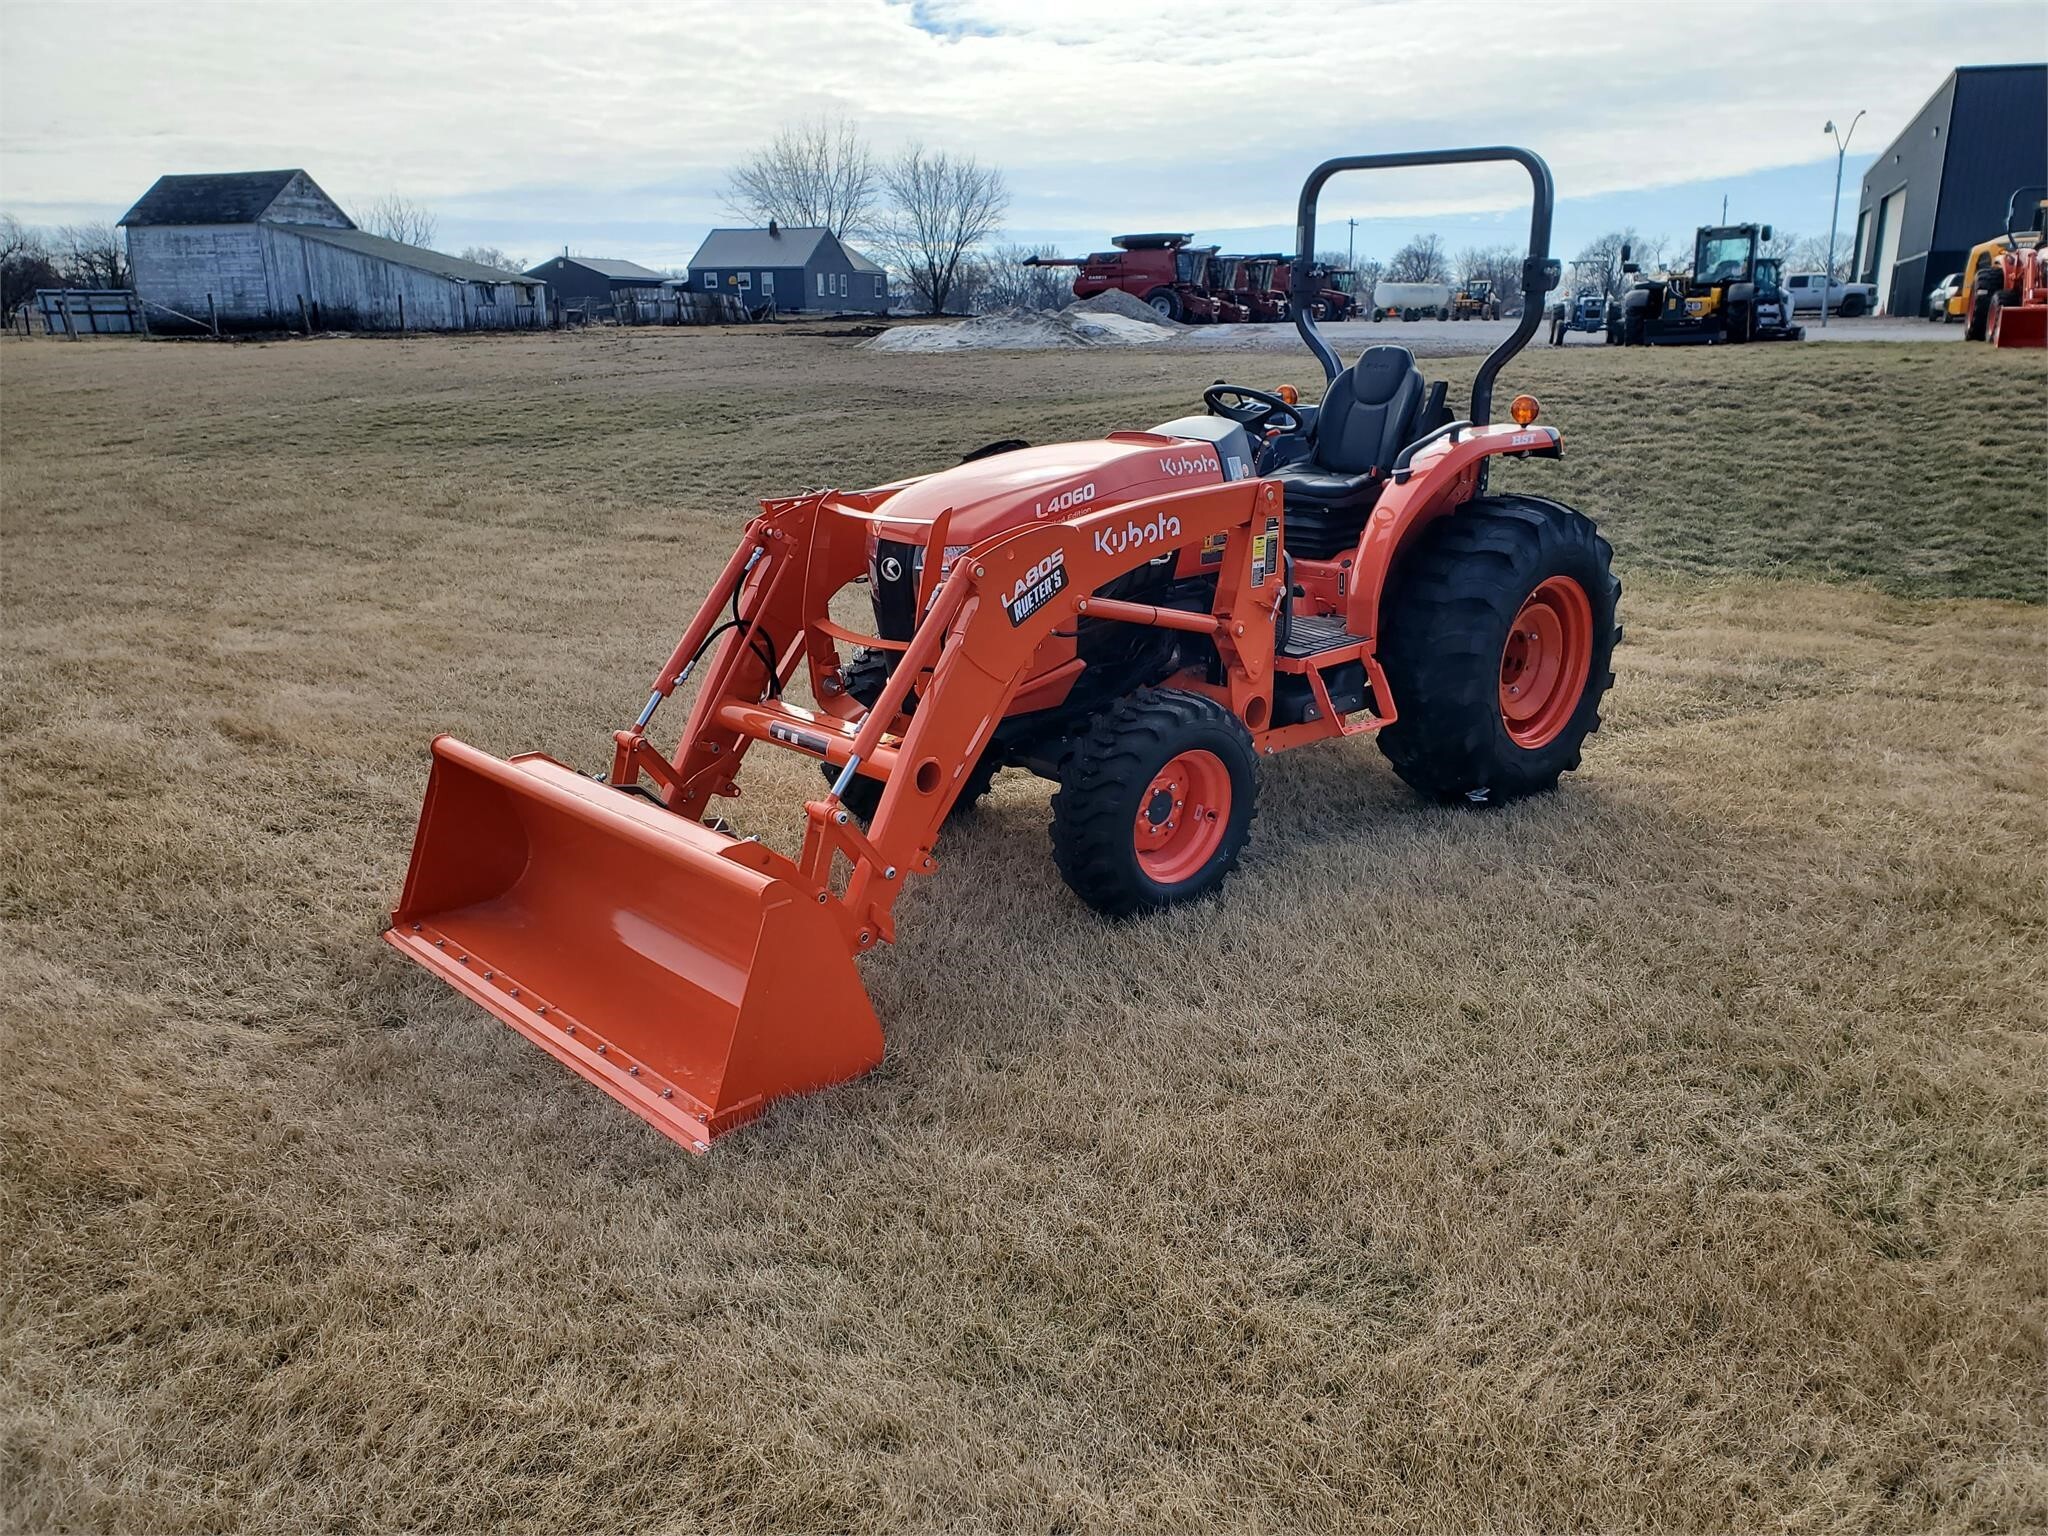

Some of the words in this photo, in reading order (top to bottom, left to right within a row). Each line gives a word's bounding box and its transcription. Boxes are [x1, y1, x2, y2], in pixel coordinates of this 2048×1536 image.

[1511, 433, 1537, 446] HST
[1159, 453, 1218, 476] Kubota
[1035, 482, 1095, 519] L4060
[1094, 512, 1181, 556] Kubota
[1000, 547, 1065, 609] LA805
[1013, 569, 1063, 623] RUETER'S
